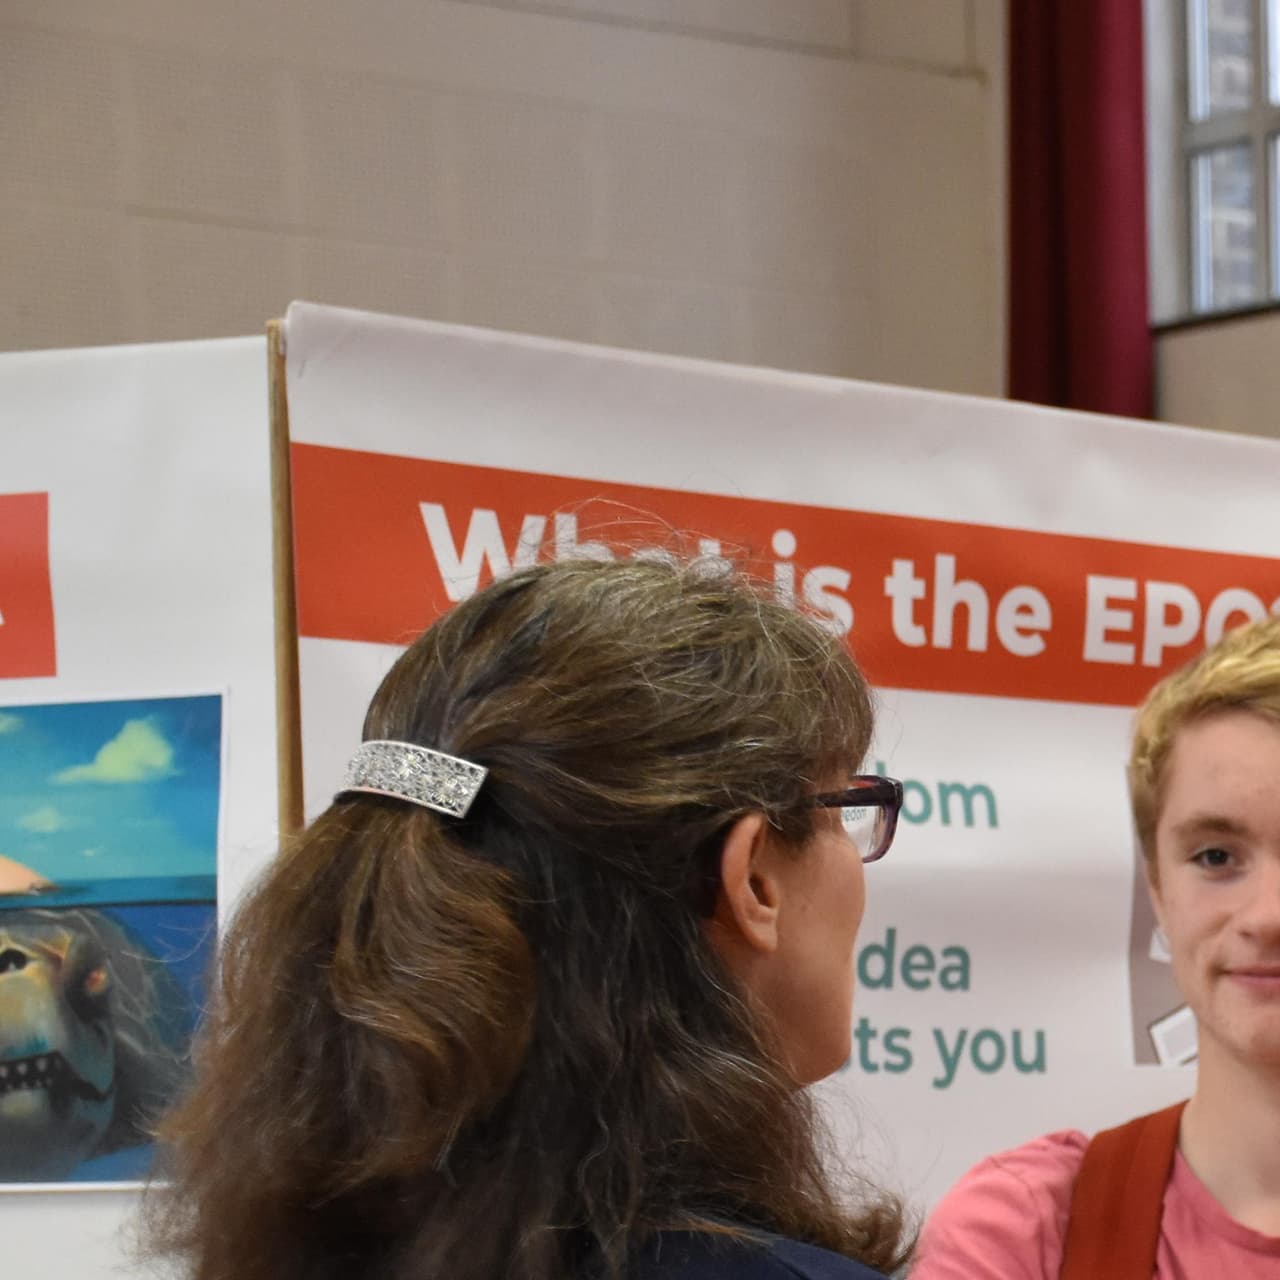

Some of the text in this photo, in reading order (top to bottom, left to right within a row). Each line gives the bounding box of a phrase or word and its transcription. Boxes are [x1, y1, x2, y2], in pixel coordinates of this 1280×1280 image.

[772, 529, 853, 637] is
[884, 553, 1052, 657] the
[876, 761, 998, 828] om
[842, 1017, 1047, 1090] ts you
